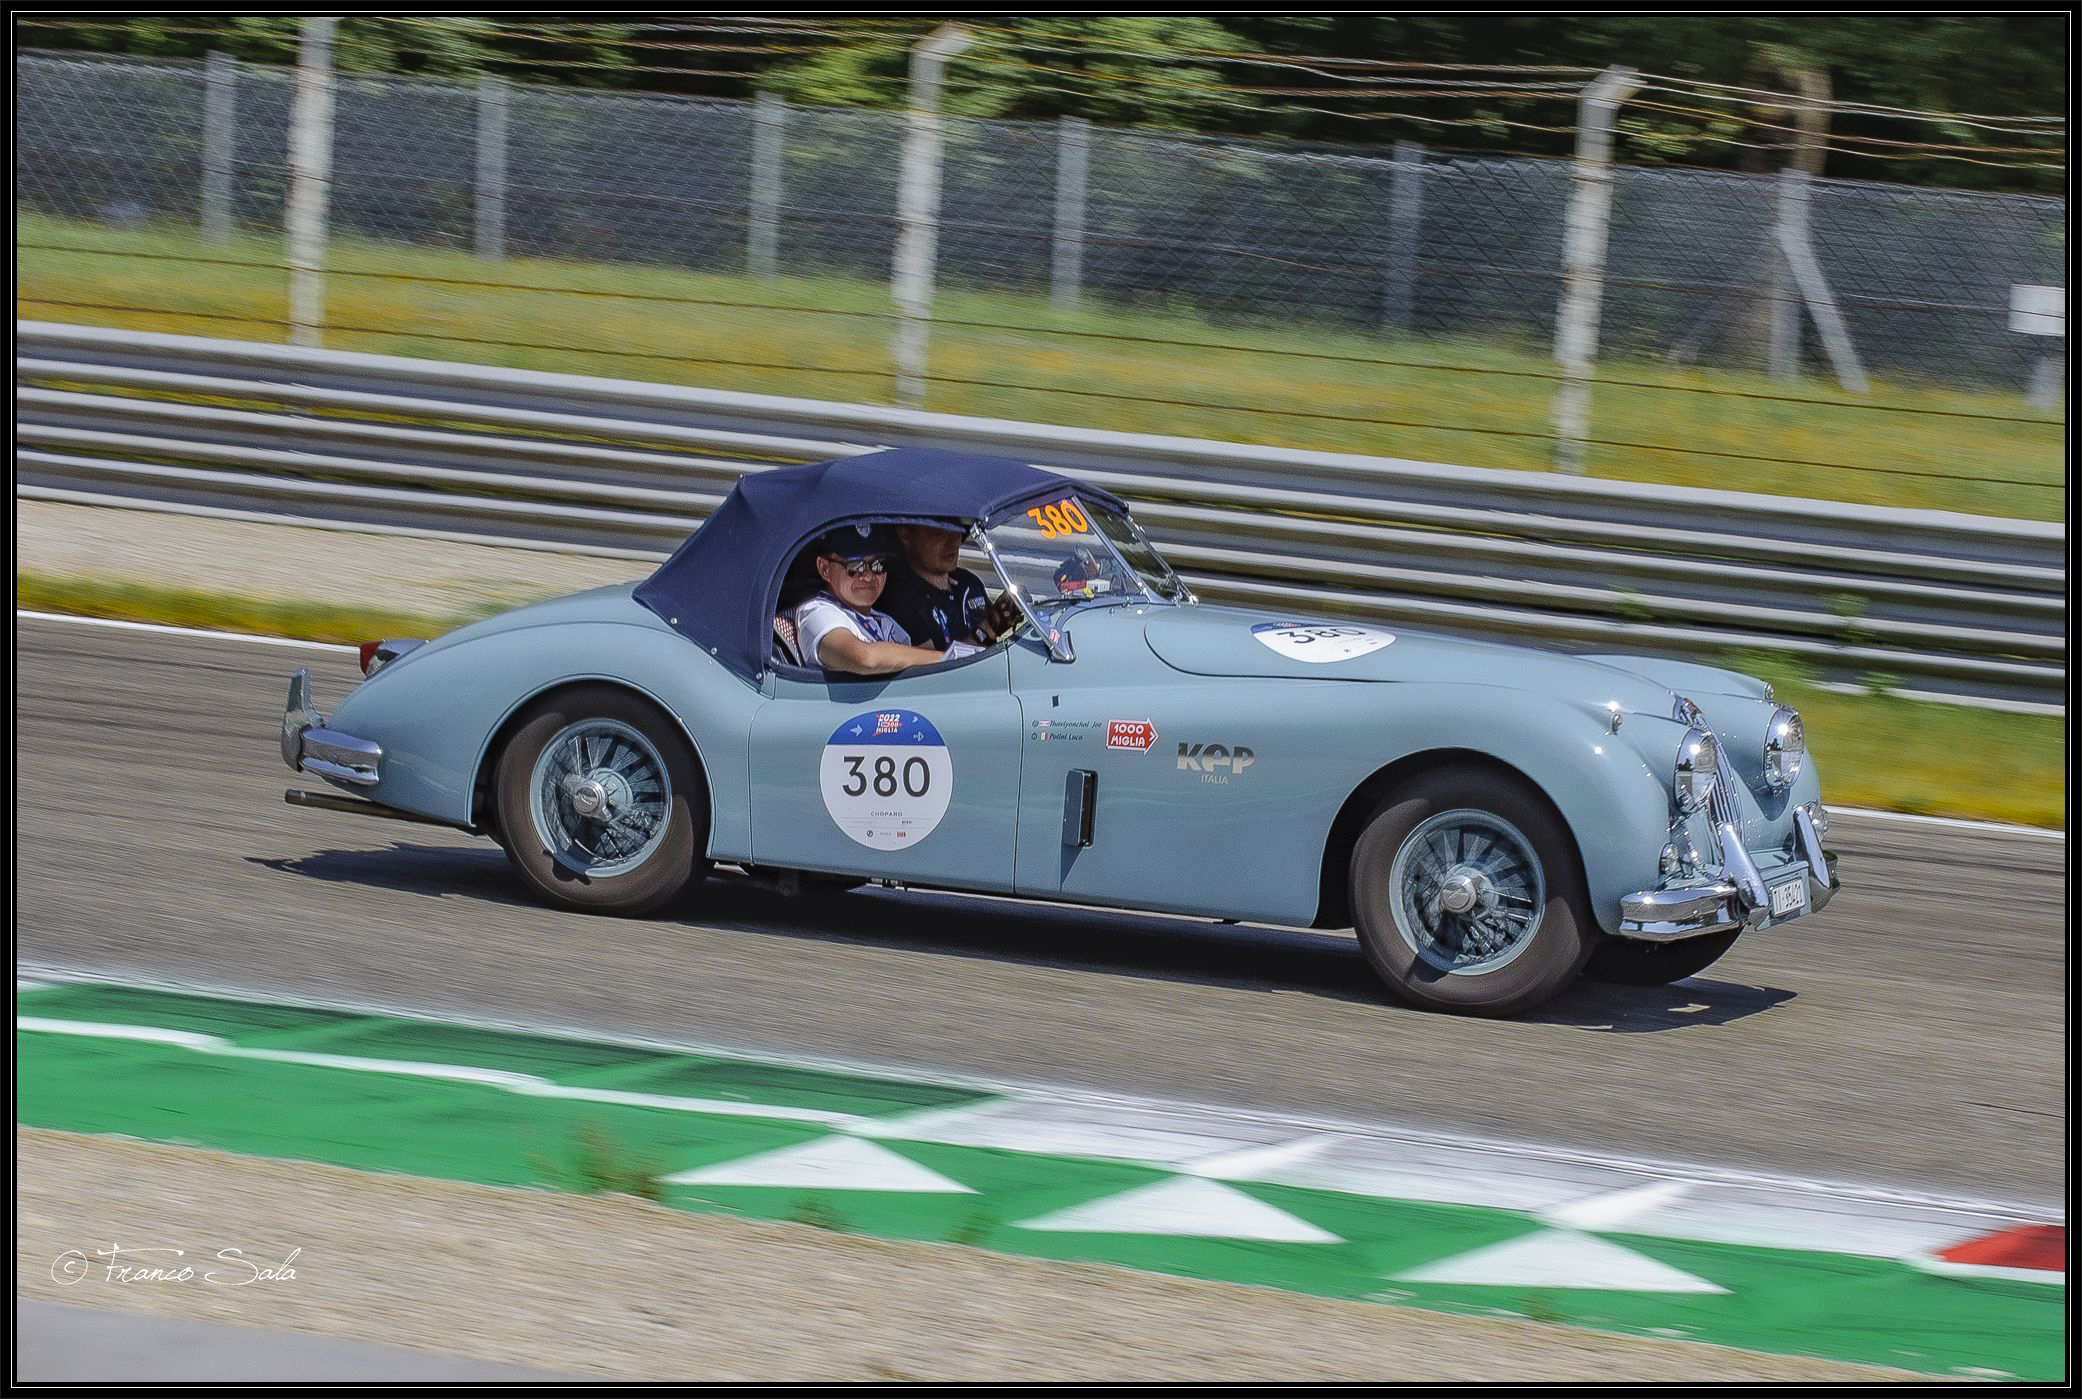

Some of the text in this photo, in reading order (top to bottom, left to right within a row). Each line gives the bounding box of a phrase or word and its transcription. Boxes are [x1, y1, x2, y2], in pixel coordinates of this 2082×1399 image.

[1027, 500, 1089, 540] 380
[1276, 628, 1366, 644] 380
[878, 713, 901, 722] 2022
[1113, 723, 1145, 735] 1000
[1110, 735, 1146, 748] MIGLIA
[842, 756, 931, 798] 380
[1200, 774, 1229, 785] ITALIA
